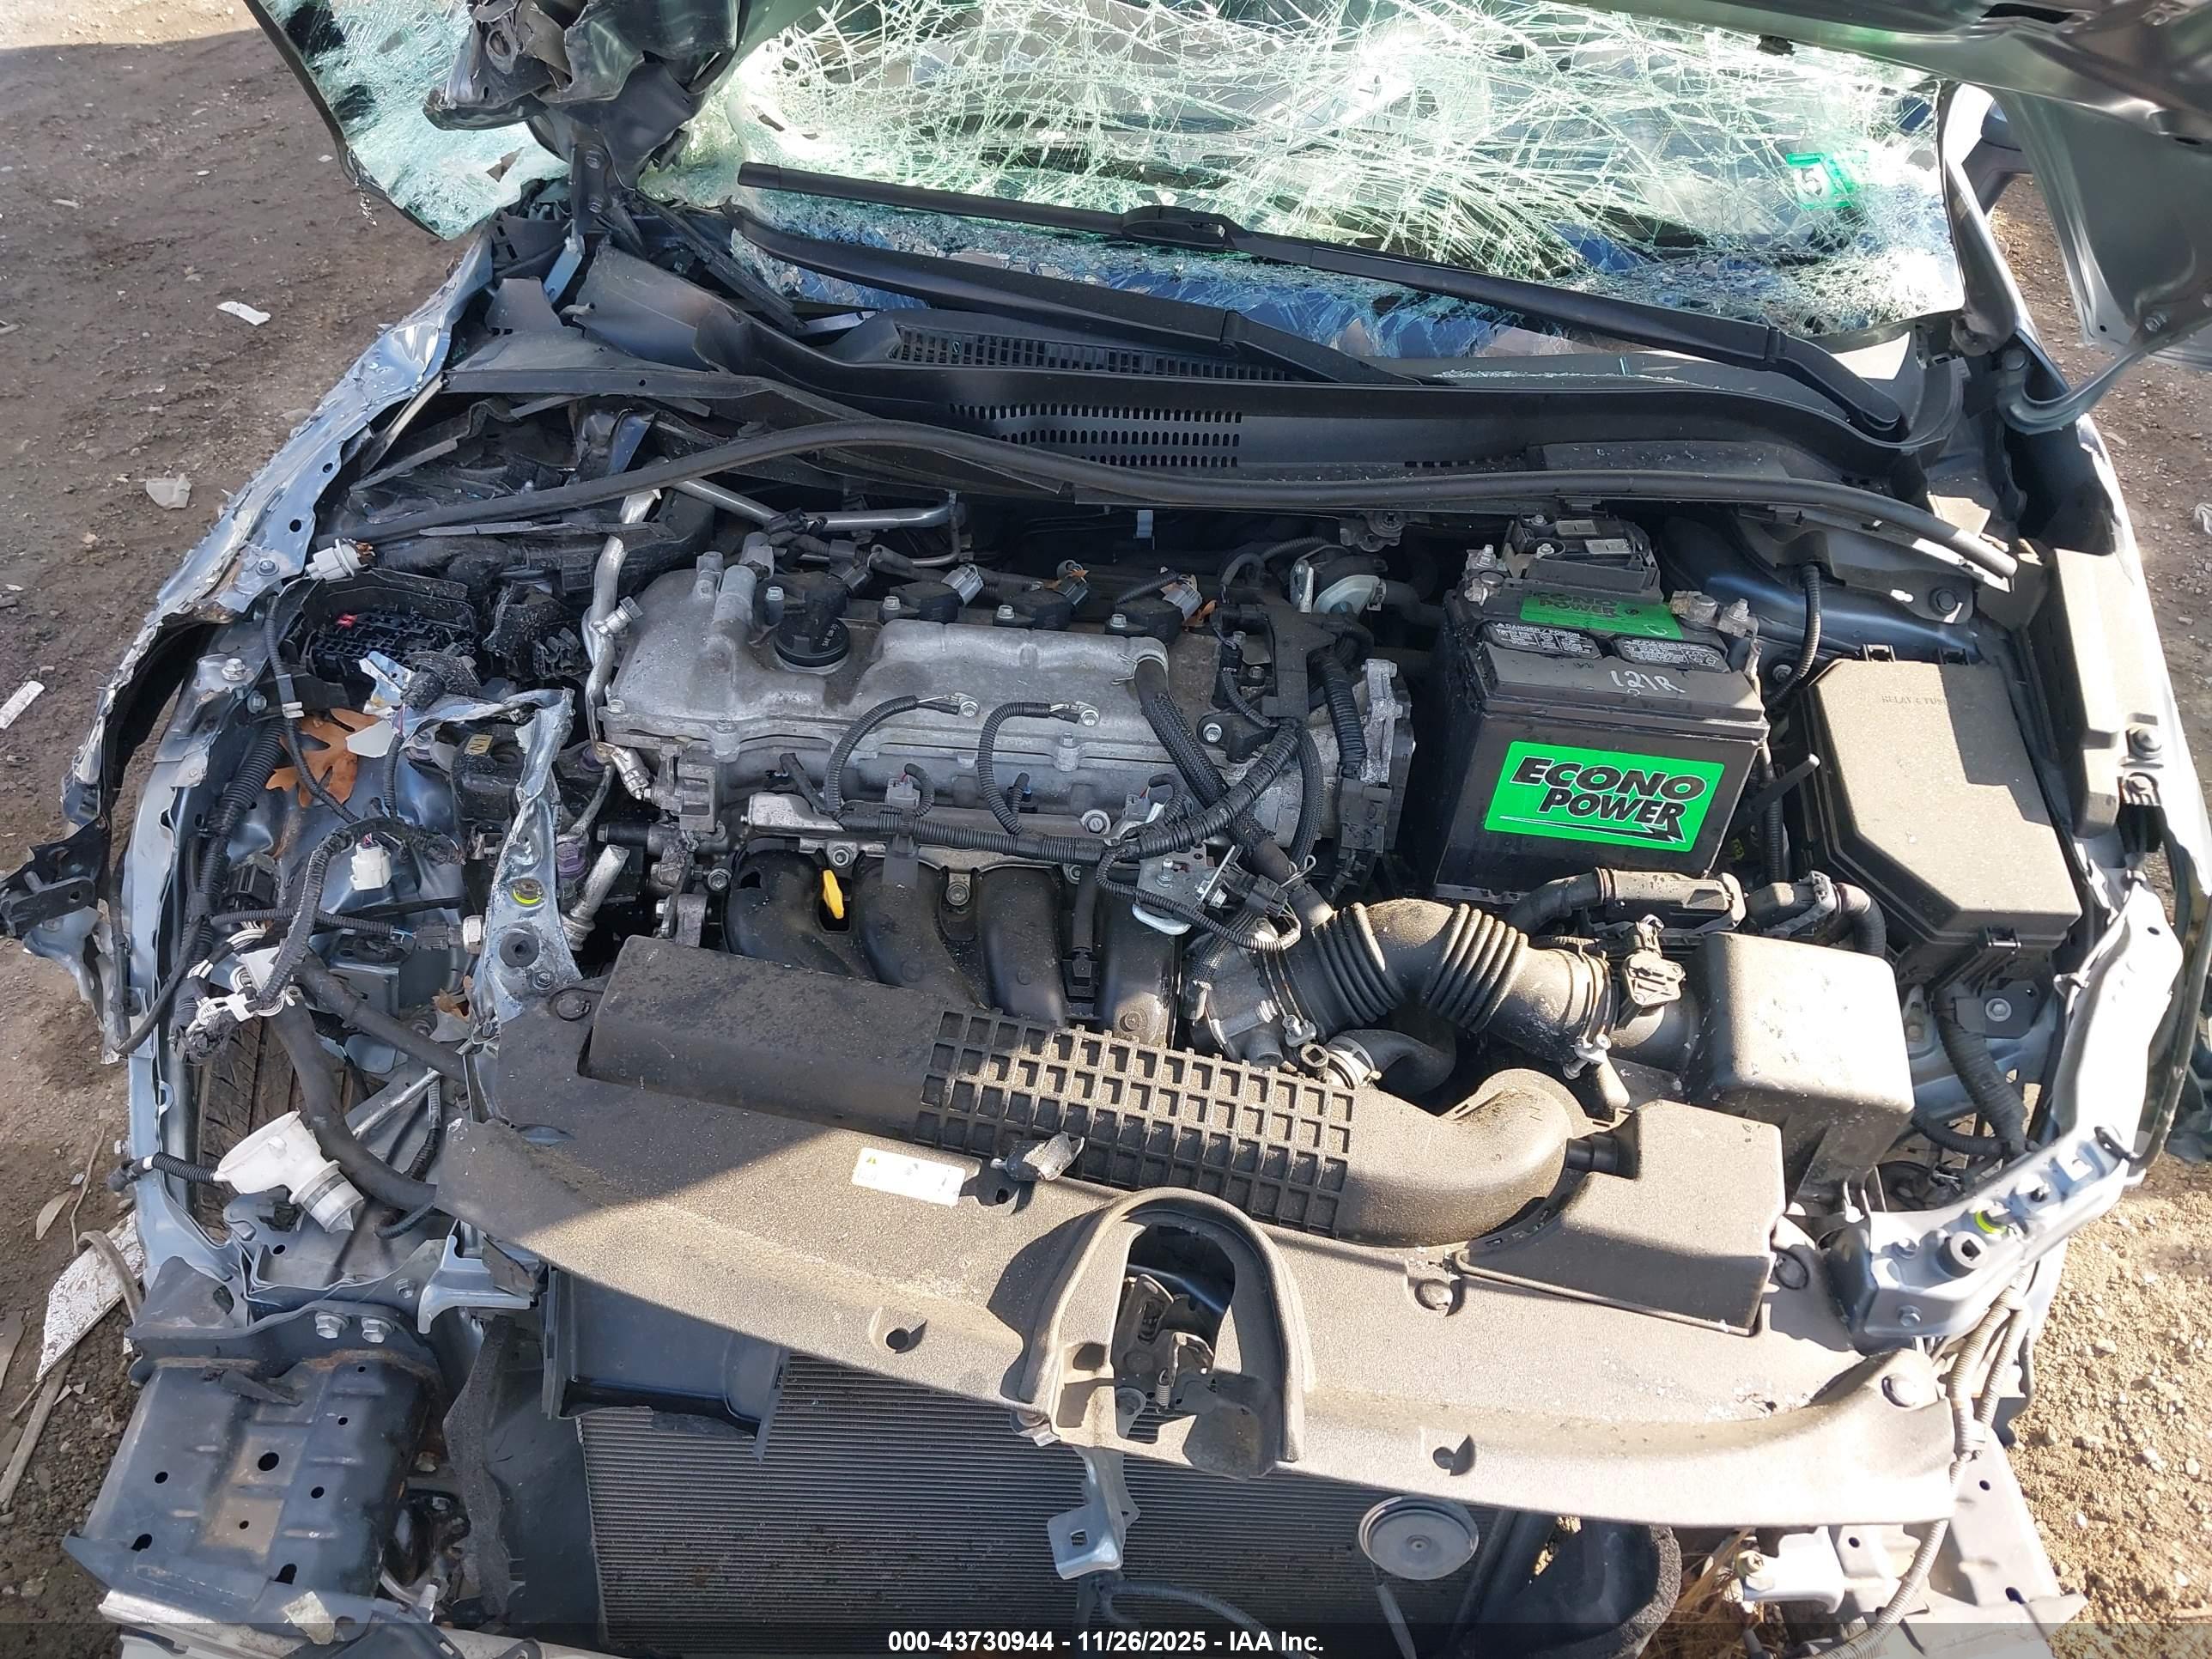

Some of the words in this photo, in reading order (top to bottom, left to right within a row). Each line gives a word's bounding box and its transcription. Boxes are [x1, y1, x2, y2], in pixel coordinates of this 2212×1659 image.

[1611, 670, 1686, 693] 121R
[1510, 756, 1707, 802] ECONO
[1537, 787, 1687, 835] POWER
